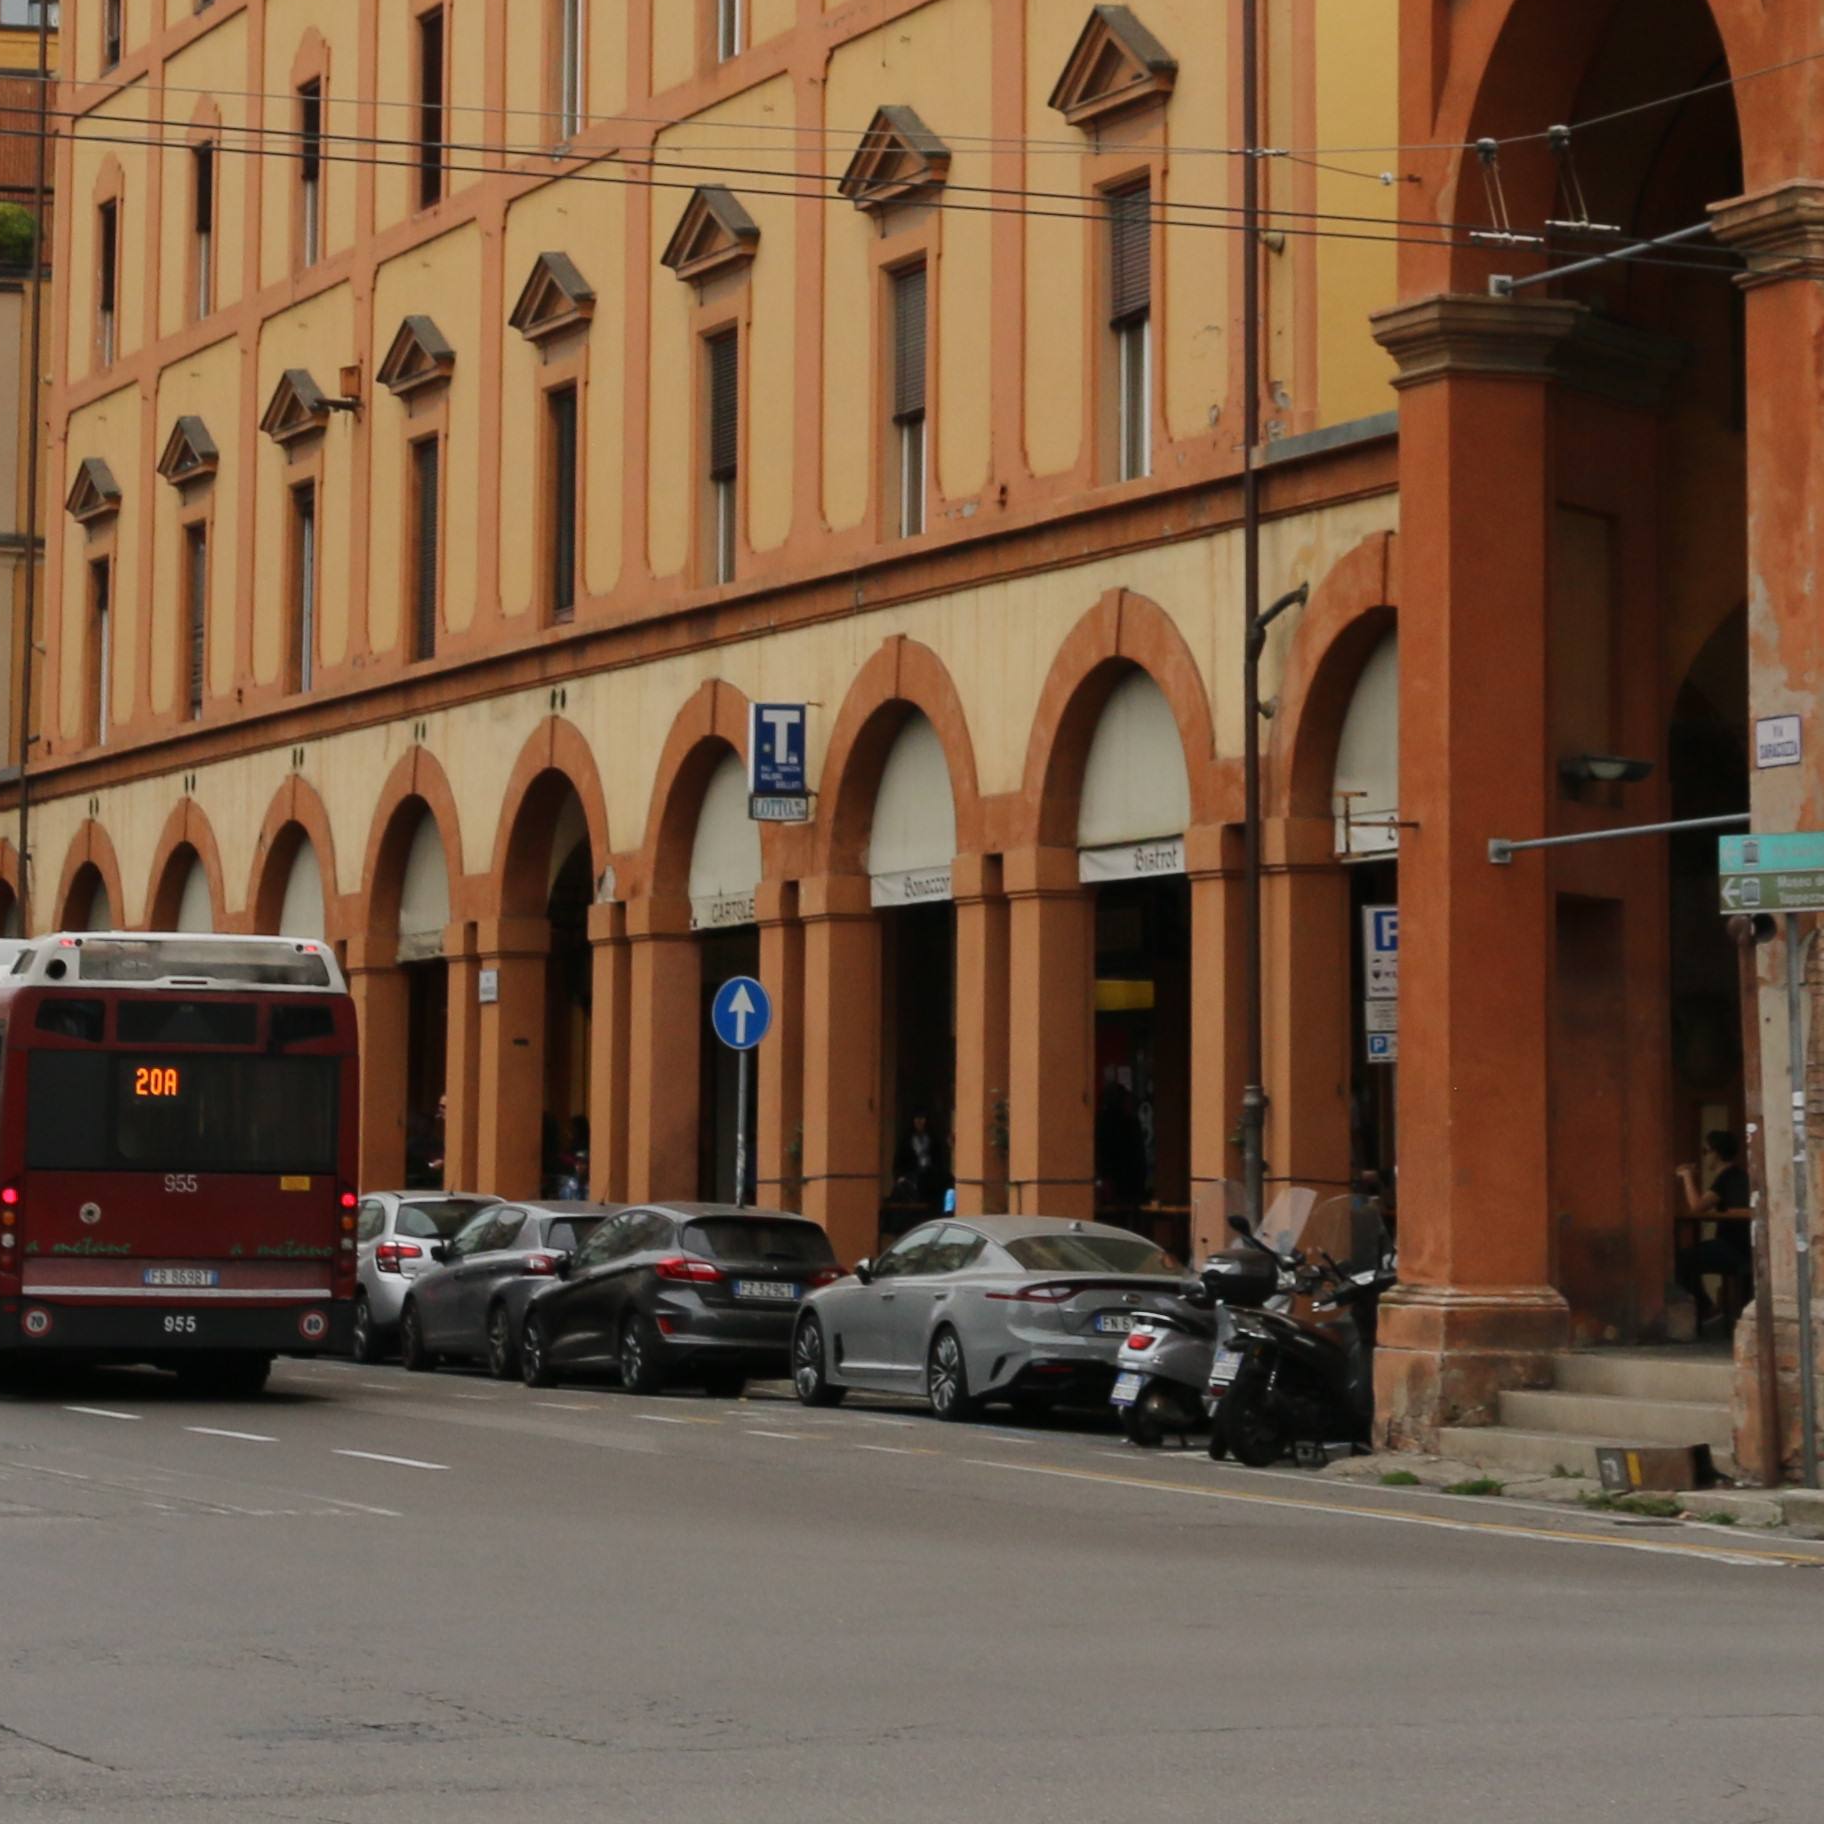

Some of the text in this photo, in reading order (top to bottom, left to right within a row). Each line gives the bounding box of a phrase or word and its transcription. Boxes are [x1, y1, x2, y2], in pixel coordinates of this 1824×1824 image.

[762, 709, 801, 764] T
[1134, 843, 1178, 872] Bistrot
[136, 1068, 177, 1096] 20A
[164, 1174, 198, 1193] 955
[163, 1315, 197, 1333] 955
